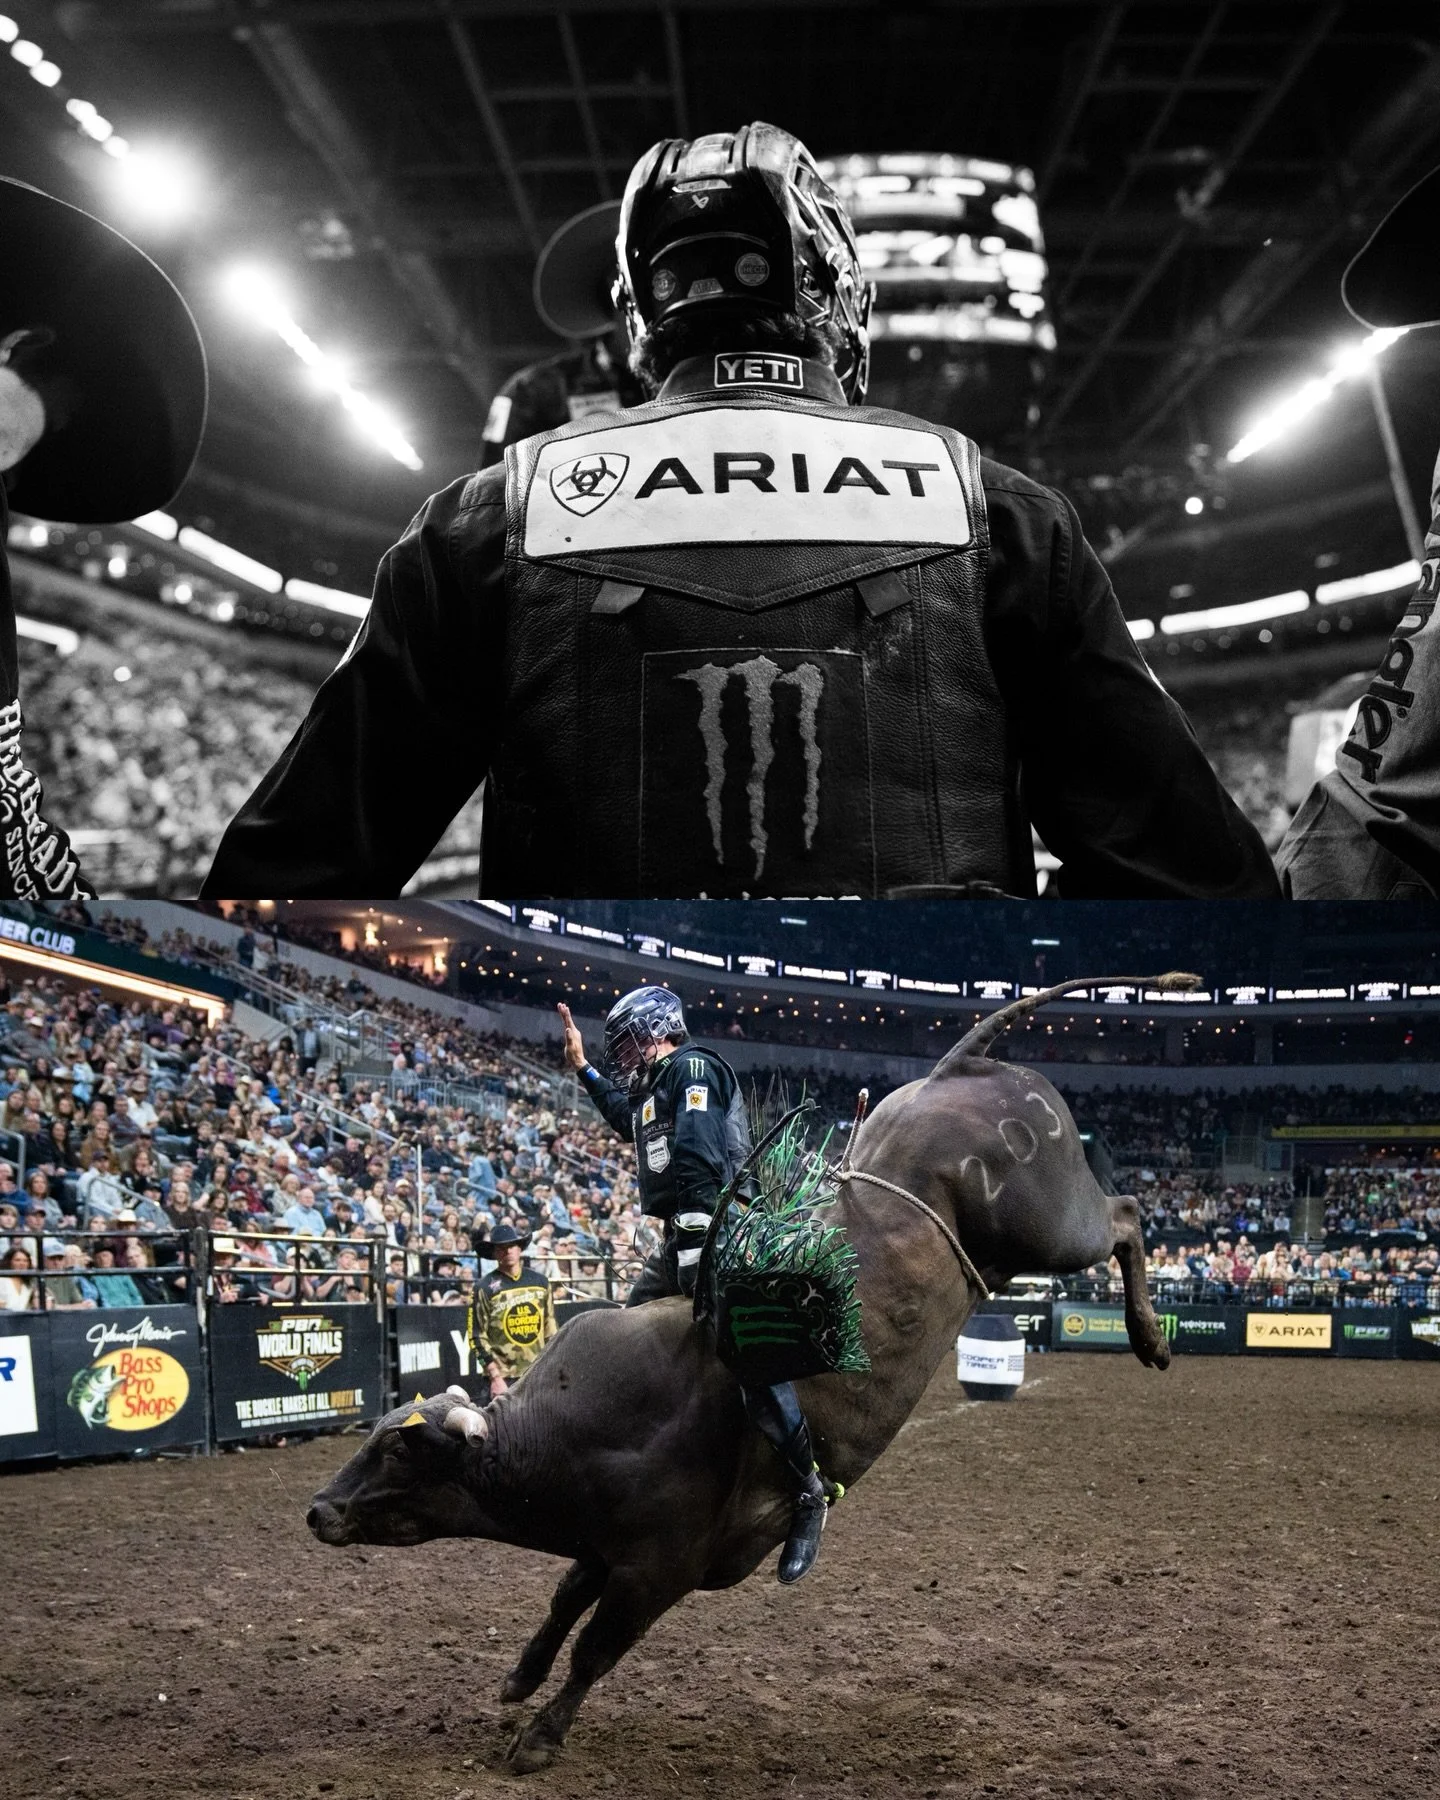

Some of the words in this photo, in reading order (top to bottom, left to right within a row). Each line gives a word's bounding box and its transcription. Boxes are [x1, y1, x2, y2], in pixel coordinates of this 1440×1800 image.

[721, 359, 796, 382] YETI
[634, 451, 940, 500] ARIAT
[6, 826, 40, 900] SINCE
[30, 926, 76, 955] CLUB
[687, 1086, 707, 1095] ARIAT
[508, 1314, 540, 1327] BORDER
[511, 1324, 539, 1336] PATROL
[1180, 1320, 1226, 1330] MONSTER
[1269, 1326, 1327, 1337] ARIAT
[258, 1333, 302, 1358] WORLD
[303, 1331, 343, 1356] FINALS
[118, 1352, 163, 1375] Bass
[961, 1353, 1005, 1364] COOPER
[966, 1360, 998, 1370] TIRES
[121, 1374, 155, 1396] Pro
[122, 1395, 177, 1420] Shops
[235, 1400, 252, 1420] THE
[252, 1397, 282, 1418] BUCKLE
[282, 1394, 308, 1414] MAKES
[308, 1393, 316, 1411] IT
